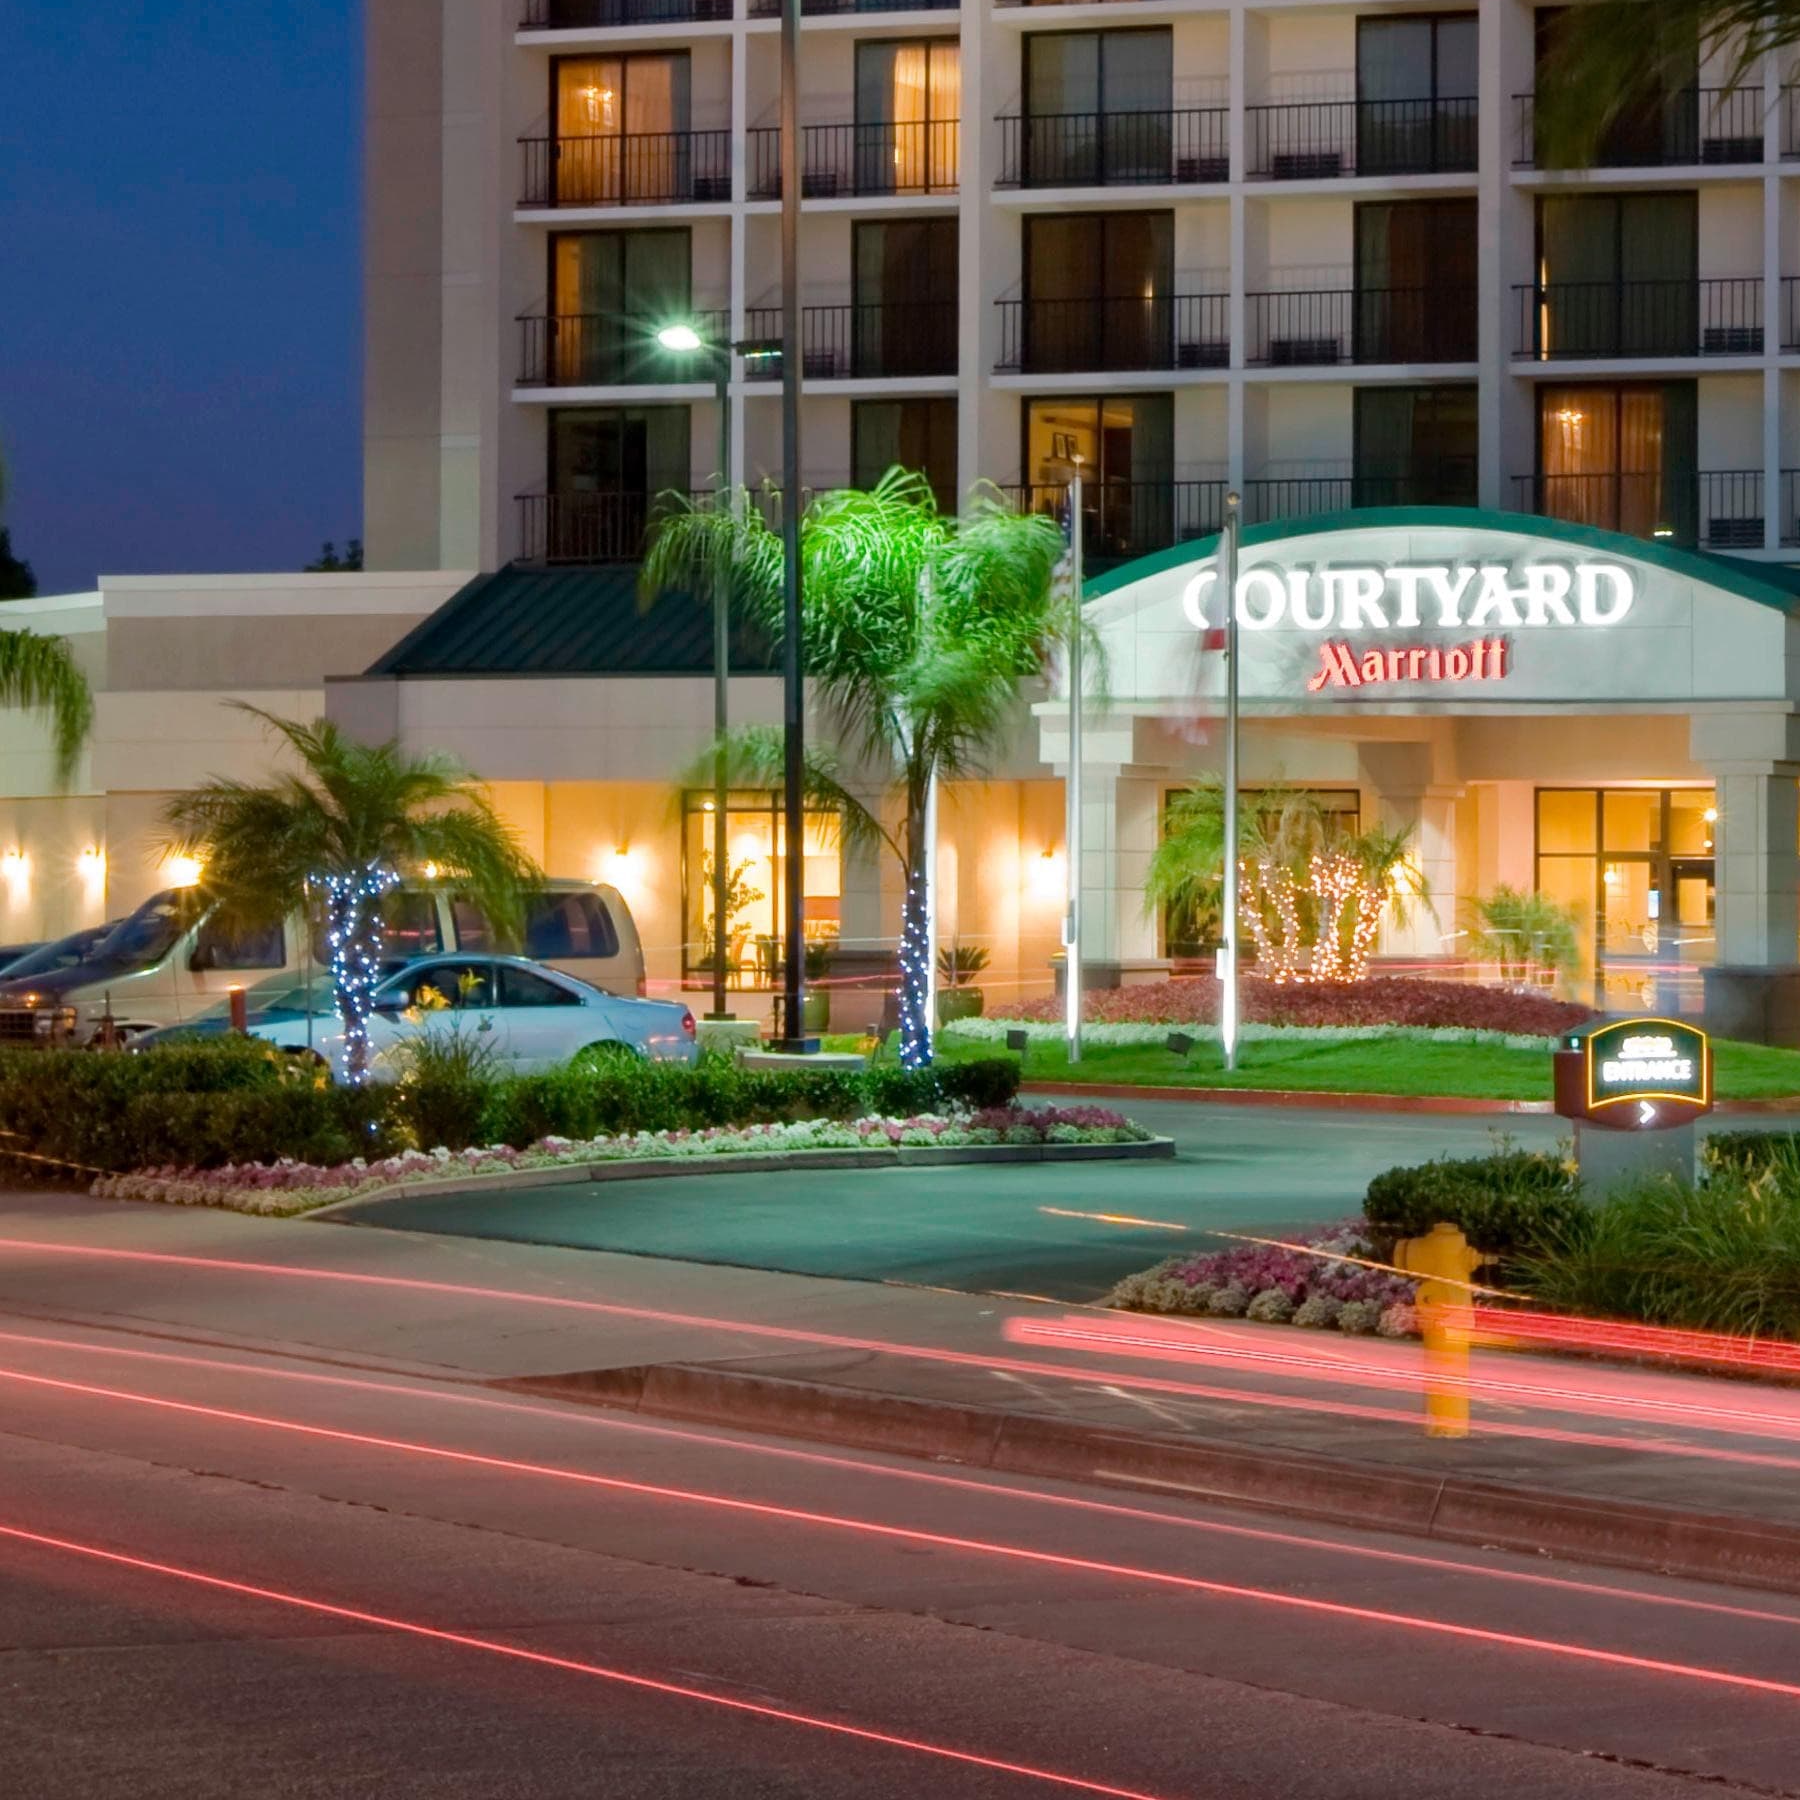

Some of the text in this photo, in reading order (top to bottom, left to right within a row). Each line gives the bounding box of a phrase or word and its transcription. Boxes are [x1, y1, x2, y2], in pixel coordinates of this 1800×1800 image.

[1182, 564, 1634, 631] COURTYARD
[1307, 638, 1508, 693] Marriott
[1602, 1059, 1693, 1083] ENTRANCE
